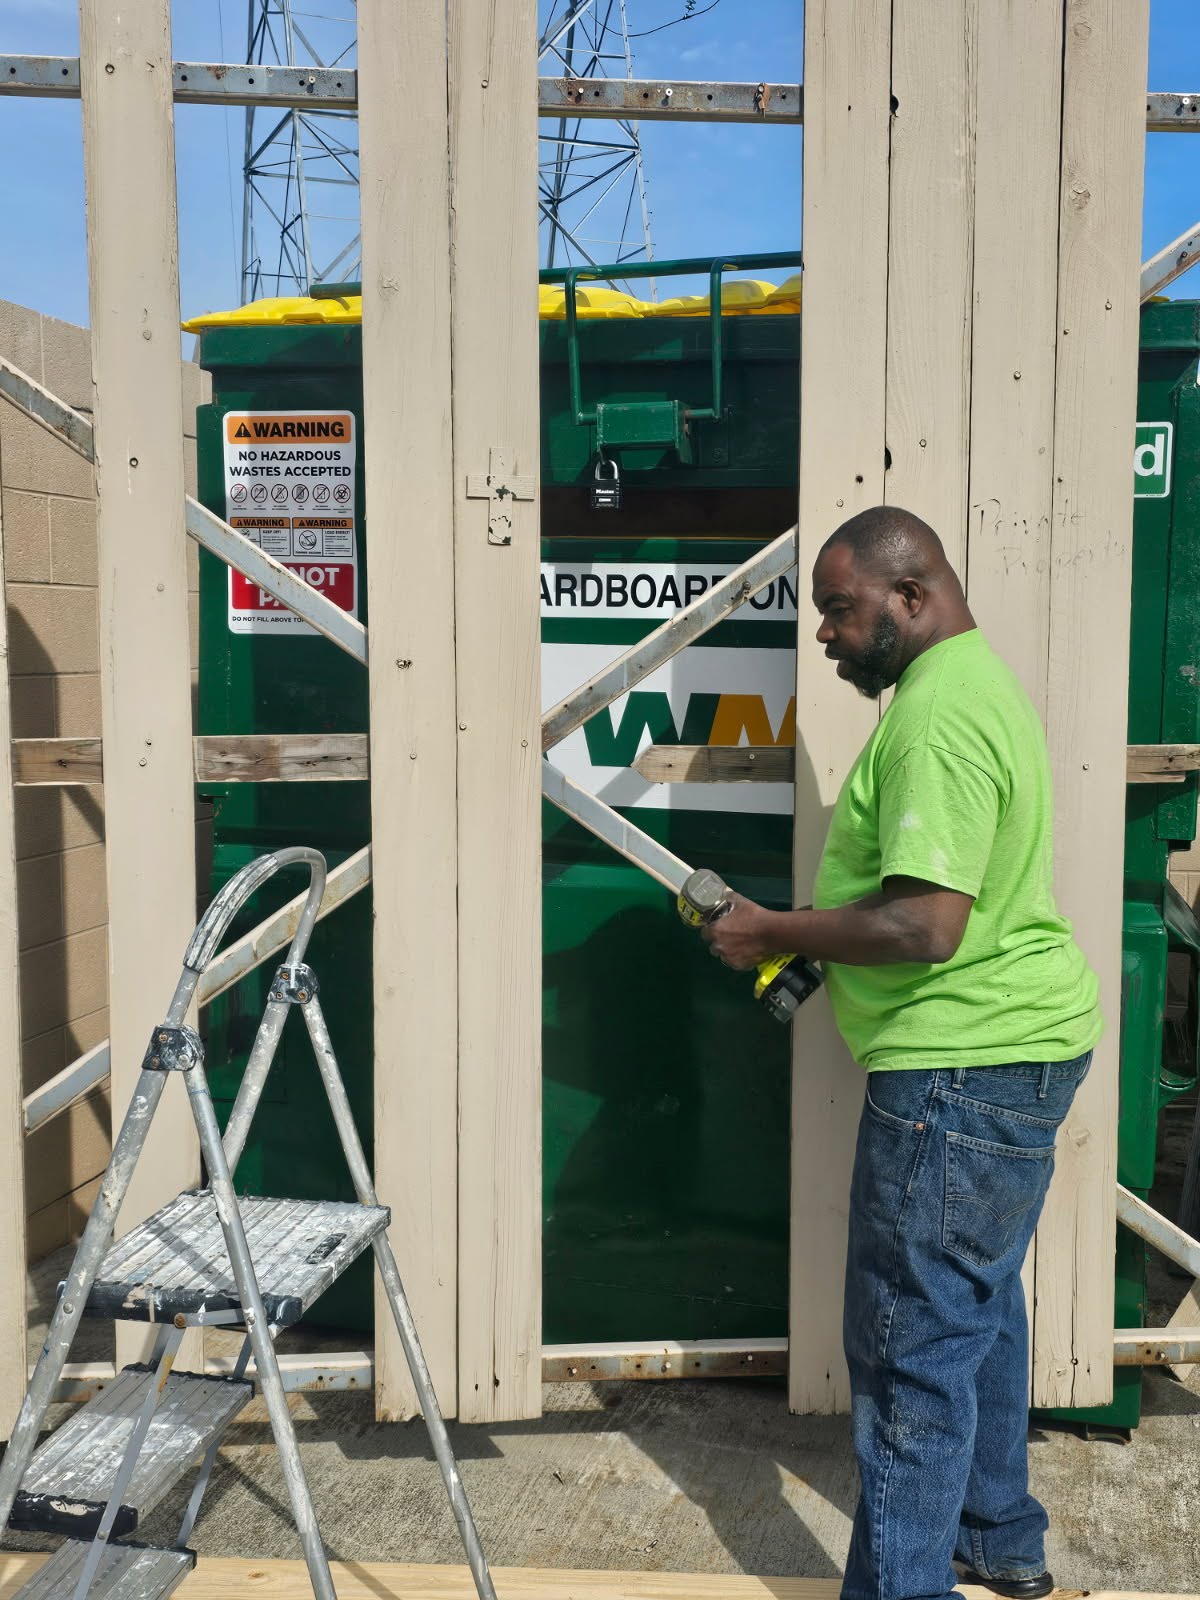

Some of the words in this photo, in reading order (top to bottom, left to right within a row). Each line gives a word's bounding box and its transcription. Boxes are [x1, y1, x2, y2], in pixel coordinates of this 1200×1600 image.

[253, 421, 345, 438] WARNING
[238, 450, 258, 462] NO
[260, 450, 341, 462] HAZARDOUS
[229, 466, 281, 477] WASTES
[284, 466, 351, 477] ACCEPTED
[243, 519, 285, 527] WARNING
[305, 519, 347, 527] WARNING
[749, 575, 798, 610] ON
